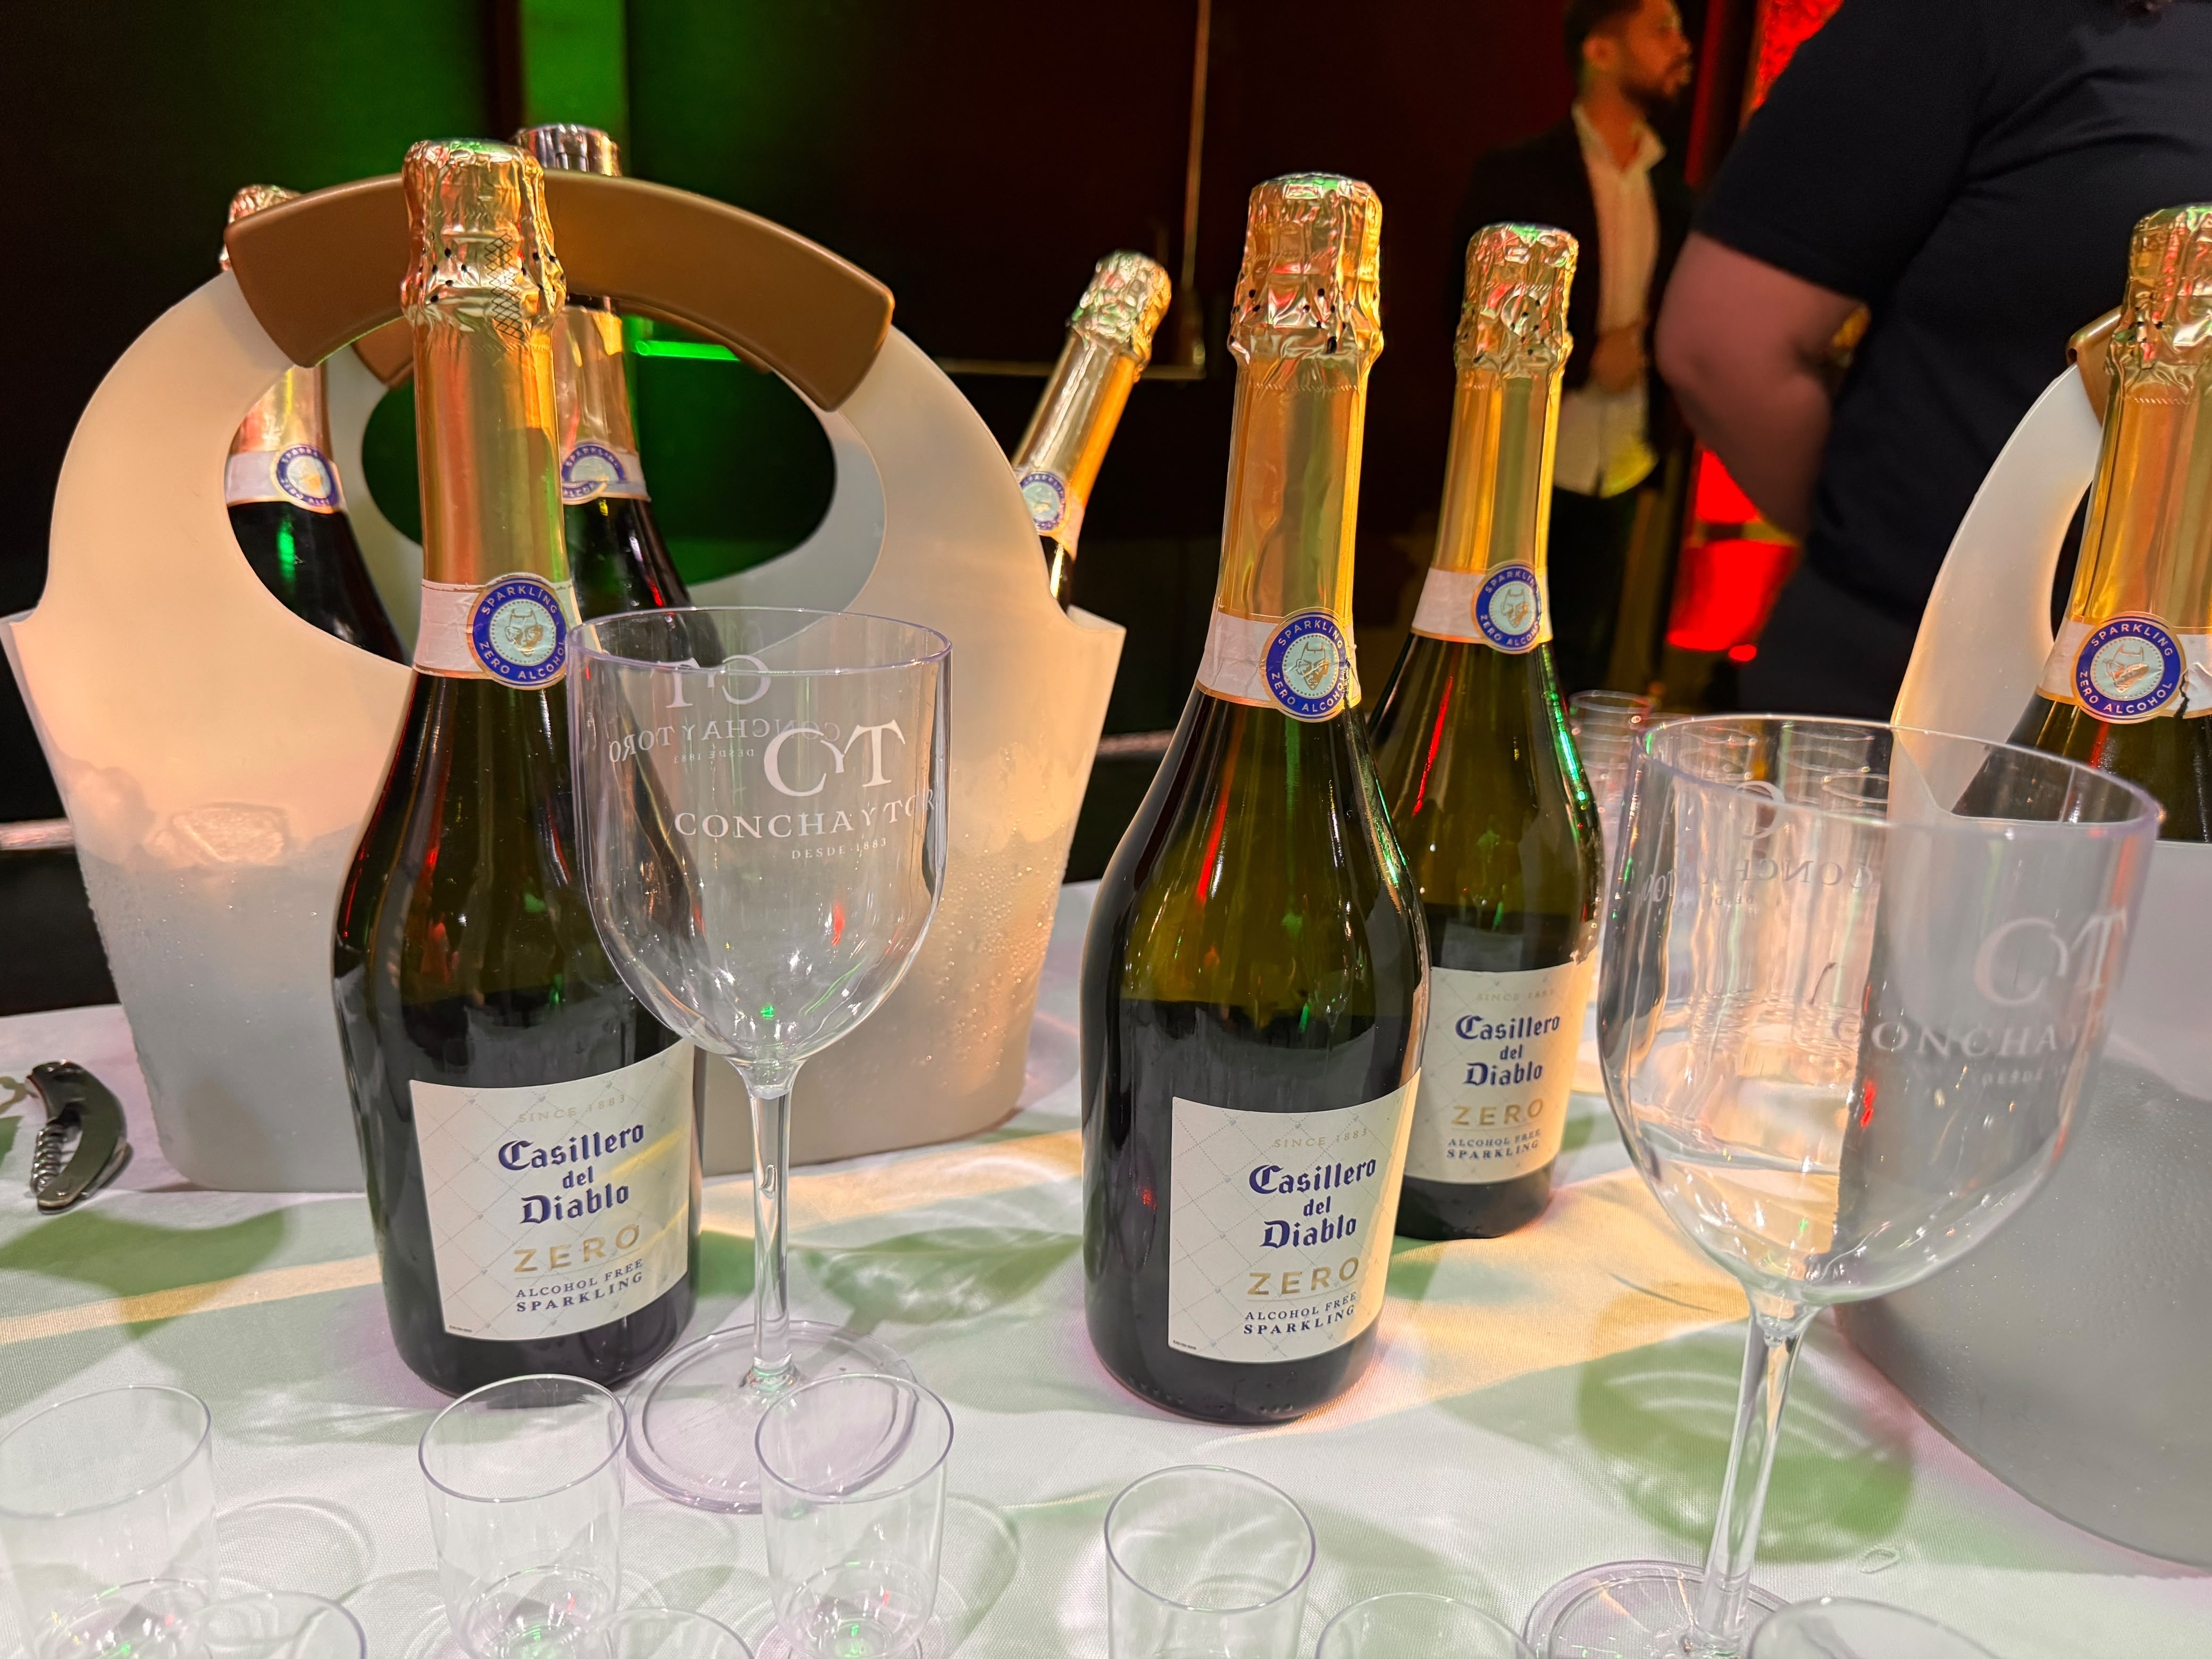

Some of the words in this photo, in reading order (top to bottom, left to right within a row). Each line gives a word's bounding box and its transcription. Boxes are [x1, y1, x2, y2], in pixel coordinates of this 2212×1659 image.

[1485, 569, 1536, 593] SPARKLIN
[482, 586, 557, 615] SPARKLING
[1278, 619, 1343, 649] SPARKLING
[1480, 615, 1502, 641] ZERO
[2091, 624, 2173, 656] SPARKLING
[480, 641, 510, 674] ZERO
[1271, 672, 1295, 705] ZERO
[2080, 671, 2099, 703] ZERO
[2104, 682, 2173, 714] ALCOHOL
[674, 811, 854, 839] CONCHA
[792, 845, 847, 860] DESDE
[857, 837, 886, 852] 1883
[1455, 1015, 1560, 1040] Casillero
[1499, 1044, 1523, 1061] del
[1462, 1061, 1543, 1086] Diablo
[517, 1107, 577, 1123] SINCE
[1451, 1098, 1544, 1126] ZERO
[498, 1123, 644, 1171] Casillero
[1274, 1136, 1326, 1148] SINCE
[1335, 1128, 1368, 1143] 1883
[1446, 1140, 1539, 1159] SPARKLING
[1448, 1137, 1511, 1147] ALCOHOL
[1515, 1128, 1541, 1143] FREE
[563, 1166, 594, 1189] del
[1249, 1158, 1377, 1195] Casillero
[520, 1182, 629, 1224] Diablo
[1303, 1195, 1331, 1217] del
[1260, 1214, 1357, 1249] Diablo
[514, 1225, 640, 1273] ZERO
[516, 1277, 598, 1298] ALCOHOL
[605, 1259, 643, 1283] FREE
[1247, 1256, 1359, 1295] ZERO
[517, 1271, 643, 1312] SPARKLING
[1243, 1305, 1355, 1335] SPARKLING
[1244, 1306, 1319, 1320] ALCOHOL
[1325, 1292, 1357, 1311] FREE
